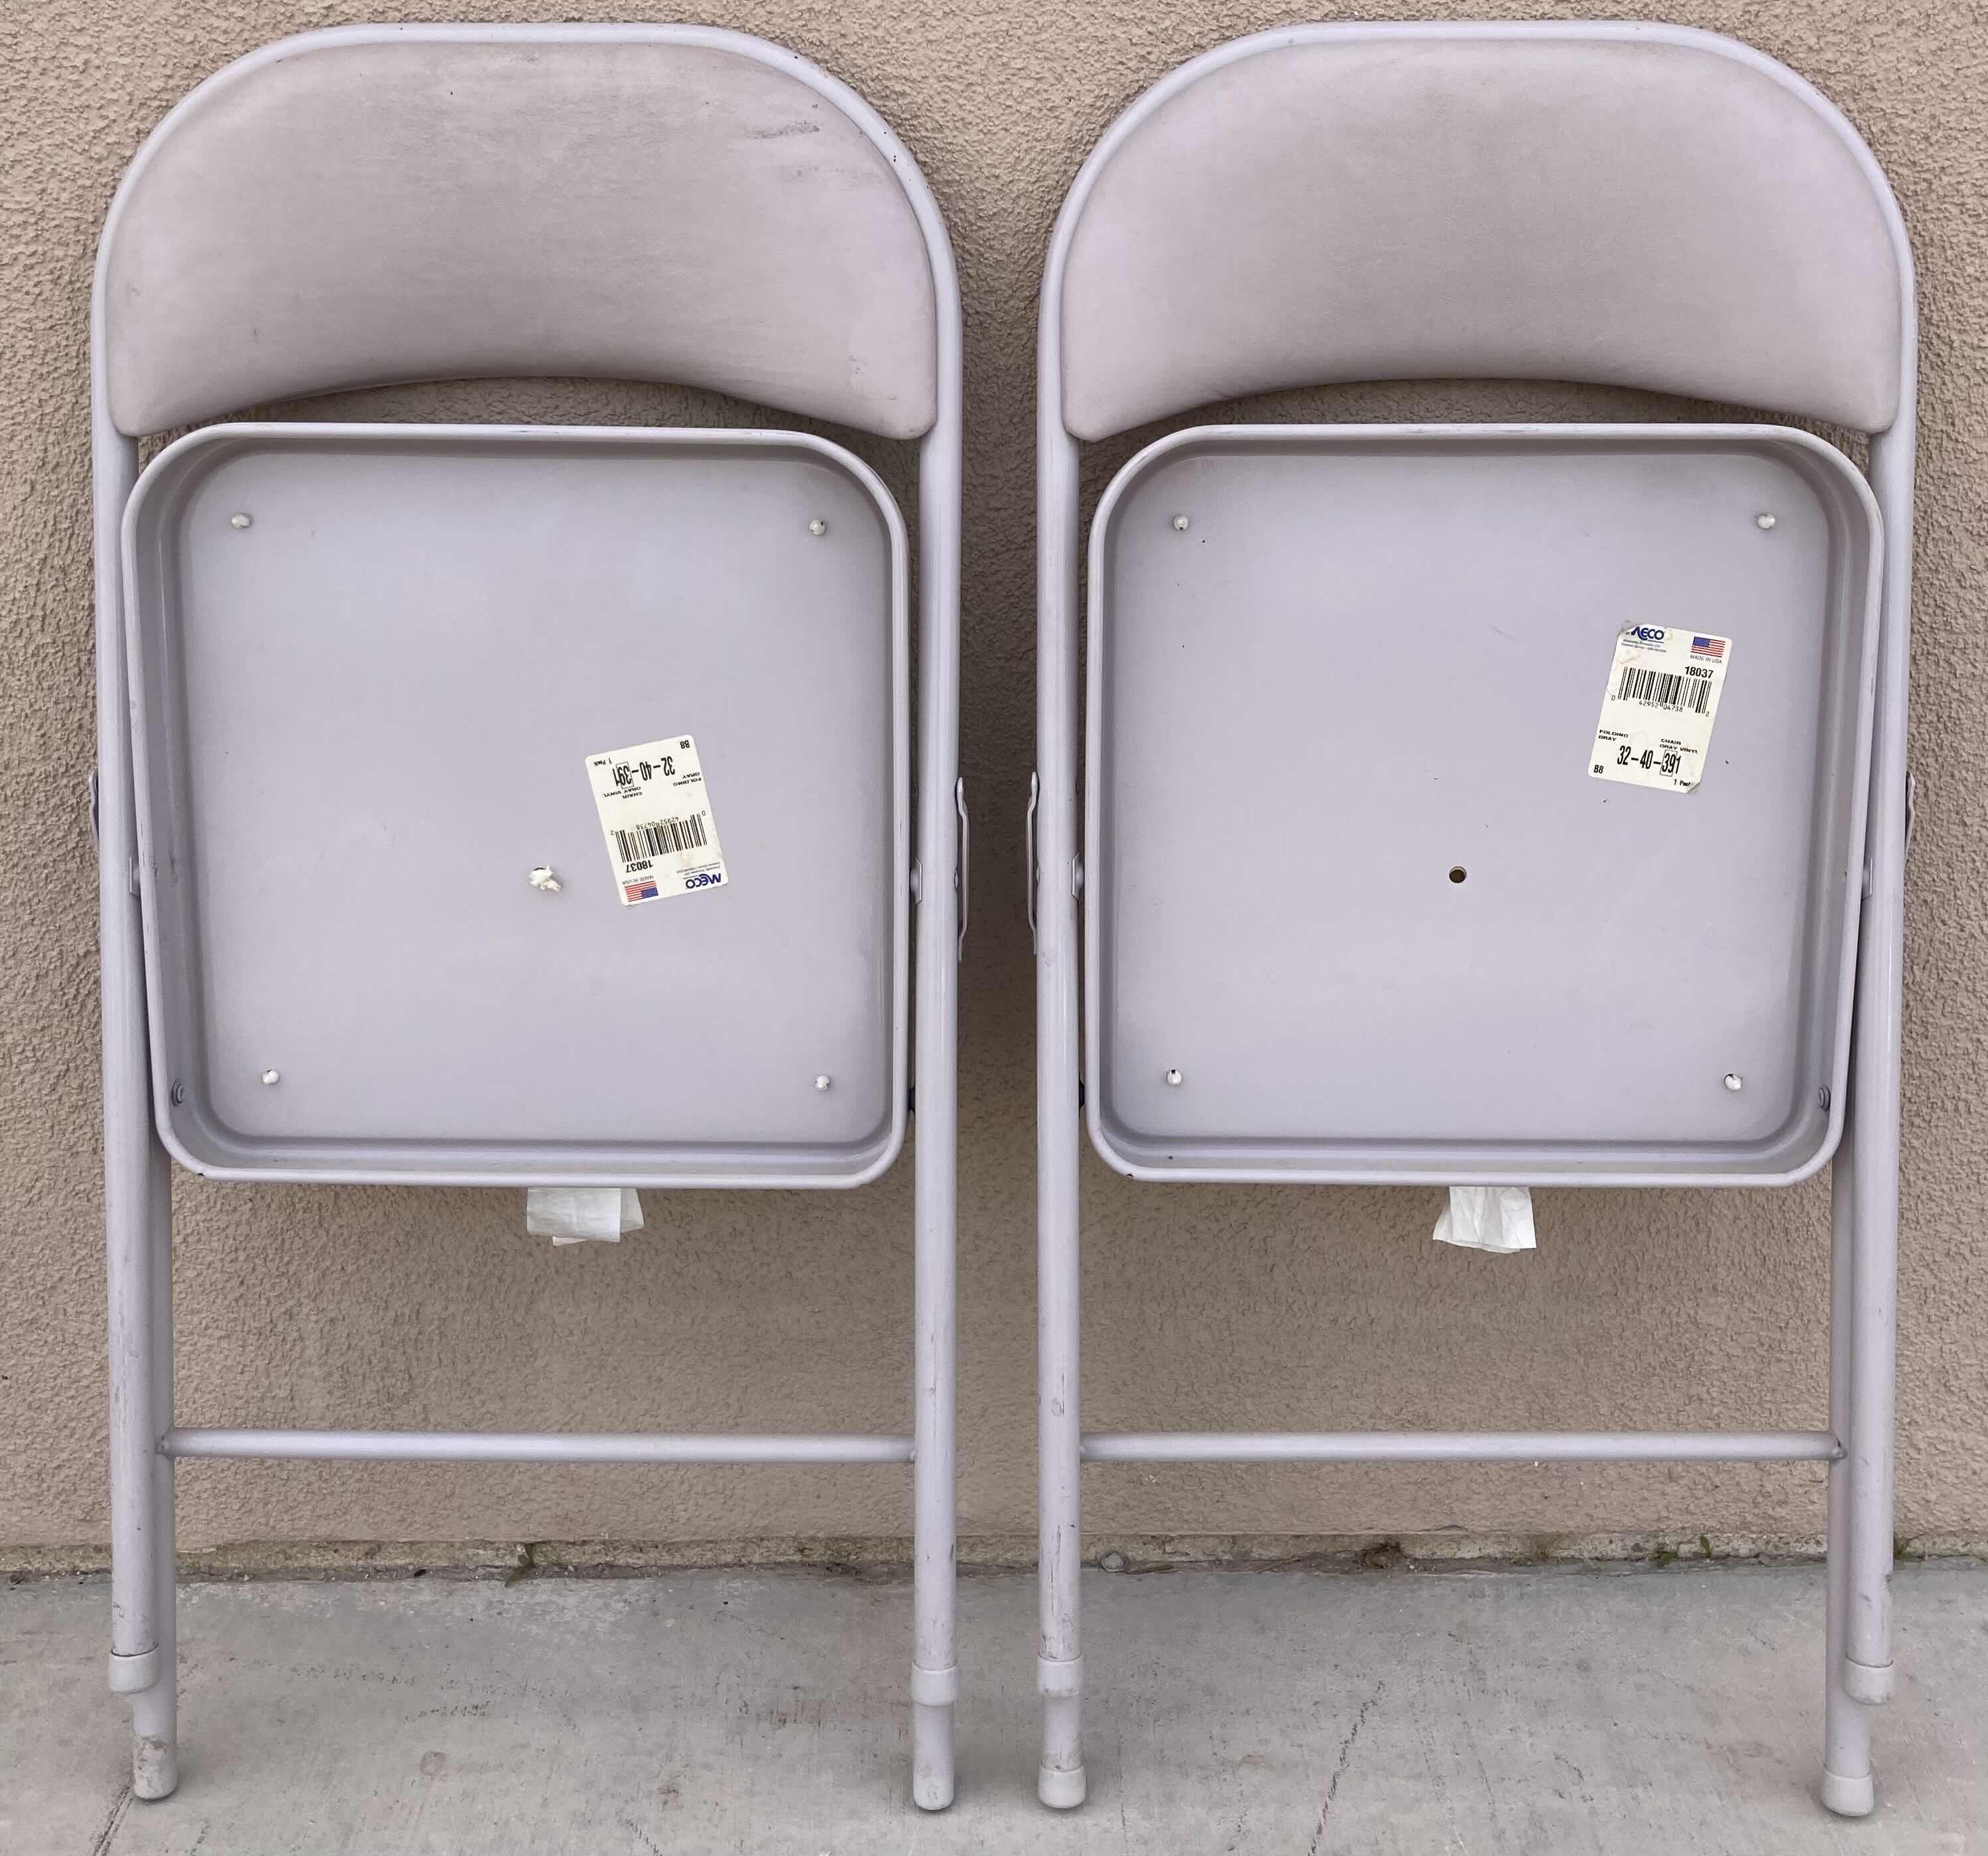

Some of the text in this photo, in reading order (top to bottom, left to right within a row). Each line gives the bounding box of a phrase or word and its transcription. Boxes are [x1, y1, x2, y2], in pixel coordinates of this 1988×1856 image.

[1685, 666, 1714, 678] 18037
[1639, 700, 1659, 708] 42952
[1663, 704, 1683, 713] 04738
[1599, 730, 1629, 738] FOLDING
[680, 740, 690, 750] B8
[1617, 745, 1681, 774] 32-40-391
[613, 756, 676, 787] 32-40-391
[1593, 765, 1604, 773] B8
[672, 777, 702, 786] FOLDING
[636, 821, 656, 831] 04738
[659, 816, 679, 825] 42952
[626, 860, 654, 873] 18037
[686, 873, 721, 888] MECO
